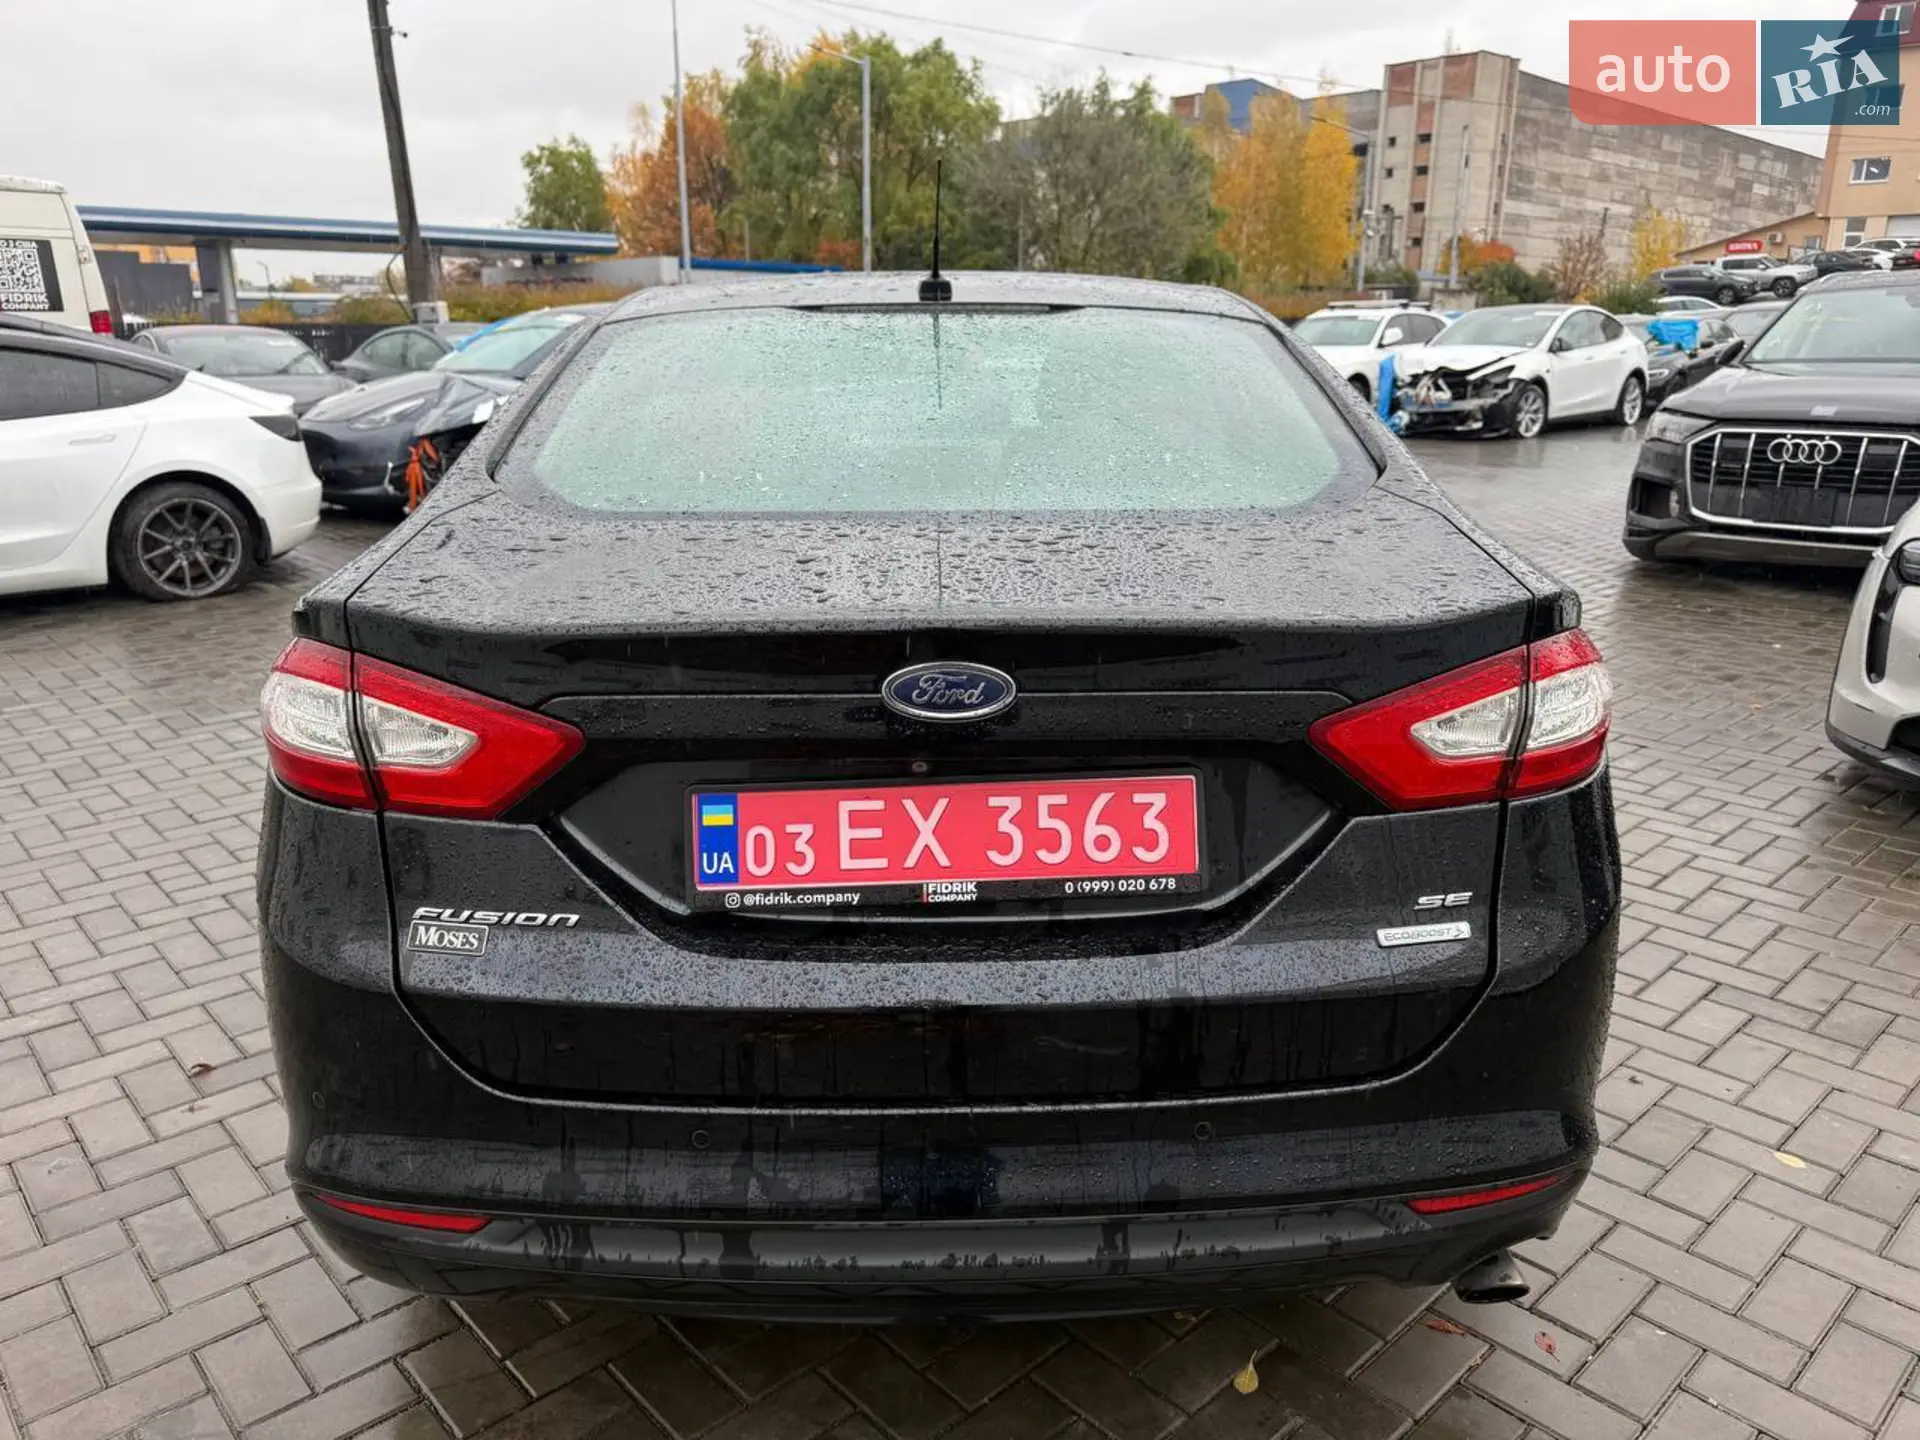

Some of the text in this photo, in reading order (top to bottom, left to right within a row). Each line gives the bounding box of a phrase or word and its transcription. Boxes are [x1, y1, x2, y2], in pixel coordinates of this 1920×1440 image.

[0, 293, 48, 303] FIDRIK
[2, 302, 49, 310] COMPANY
[911, 673, 987, 705] Ford
[745, 791, 1171, 877] 03 EX 3563
[702, 852, 735, 874] UA
[928, 881, 978, 894] FIDRIK
[1064, 877, 1177, 894] 0 (999) 020 678
[744, 891, 861, 907] @fidrik.company
[928, 892, 978, 902] COMPANY
[1413, 892, 1474, 910] SE
[412, 906, 581, 927] FUSION
[415, 925, 479, 950] MOSES
[1383, 928, 1452, 942] ECOBOOST
